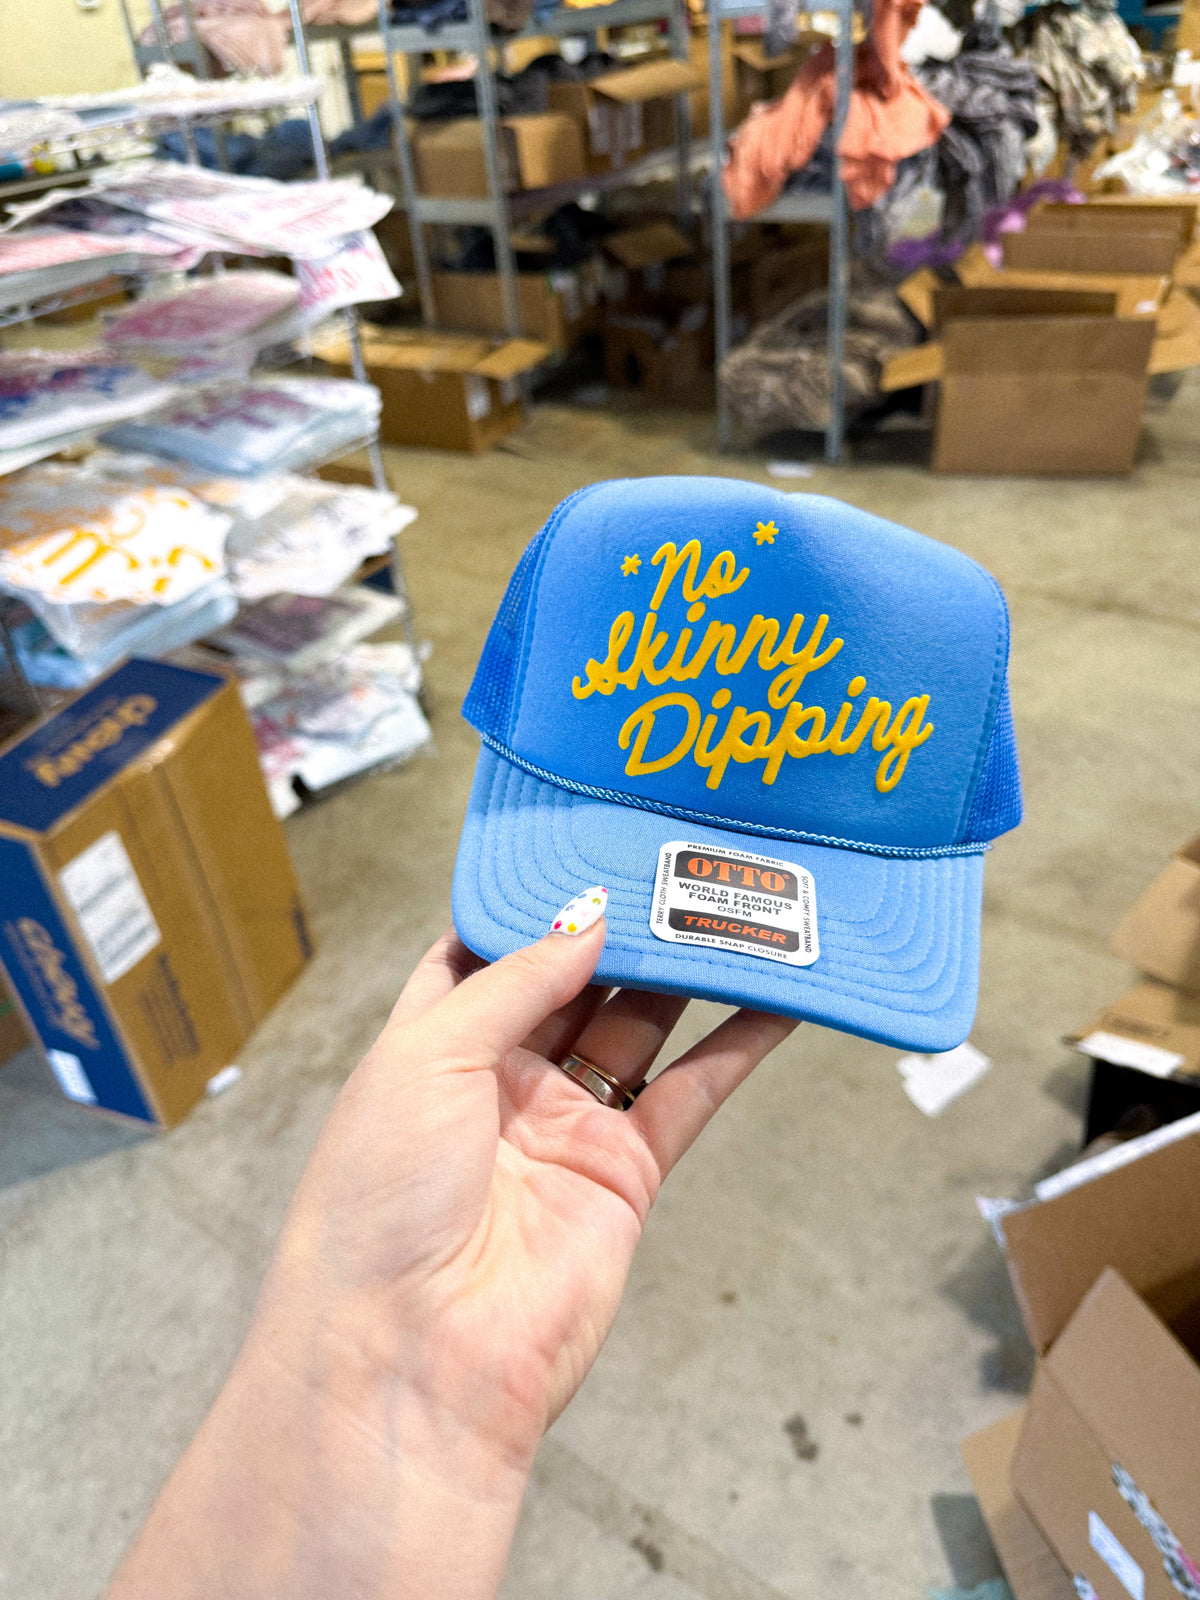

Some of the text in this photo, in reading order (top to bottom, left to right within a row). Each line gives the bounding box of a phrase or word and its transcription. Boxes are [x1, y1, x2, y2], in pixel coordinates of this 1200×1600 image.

[651, 539, 750, 611] No
[572, 601, 844, 709] Skinny
[618, 675, 934, 793] Dipping
[687, 844, 784, 867] PREMIUM FOAM FABRIC
[656, 852, 672, 924] TERRY CLOTH SWEATBAND
[679, 881, 792, 910] WORLD FAMOUS
[688, 892, 782, 915] FOAM FRONT
[717, 905, 752, 918] OSFM
[684, 915, 787, 945] TRUCKER
[803, 917, 812, 953] SWEATBAND
[675, 933, 788, 960] DURABLE SNAP CLOSURE
